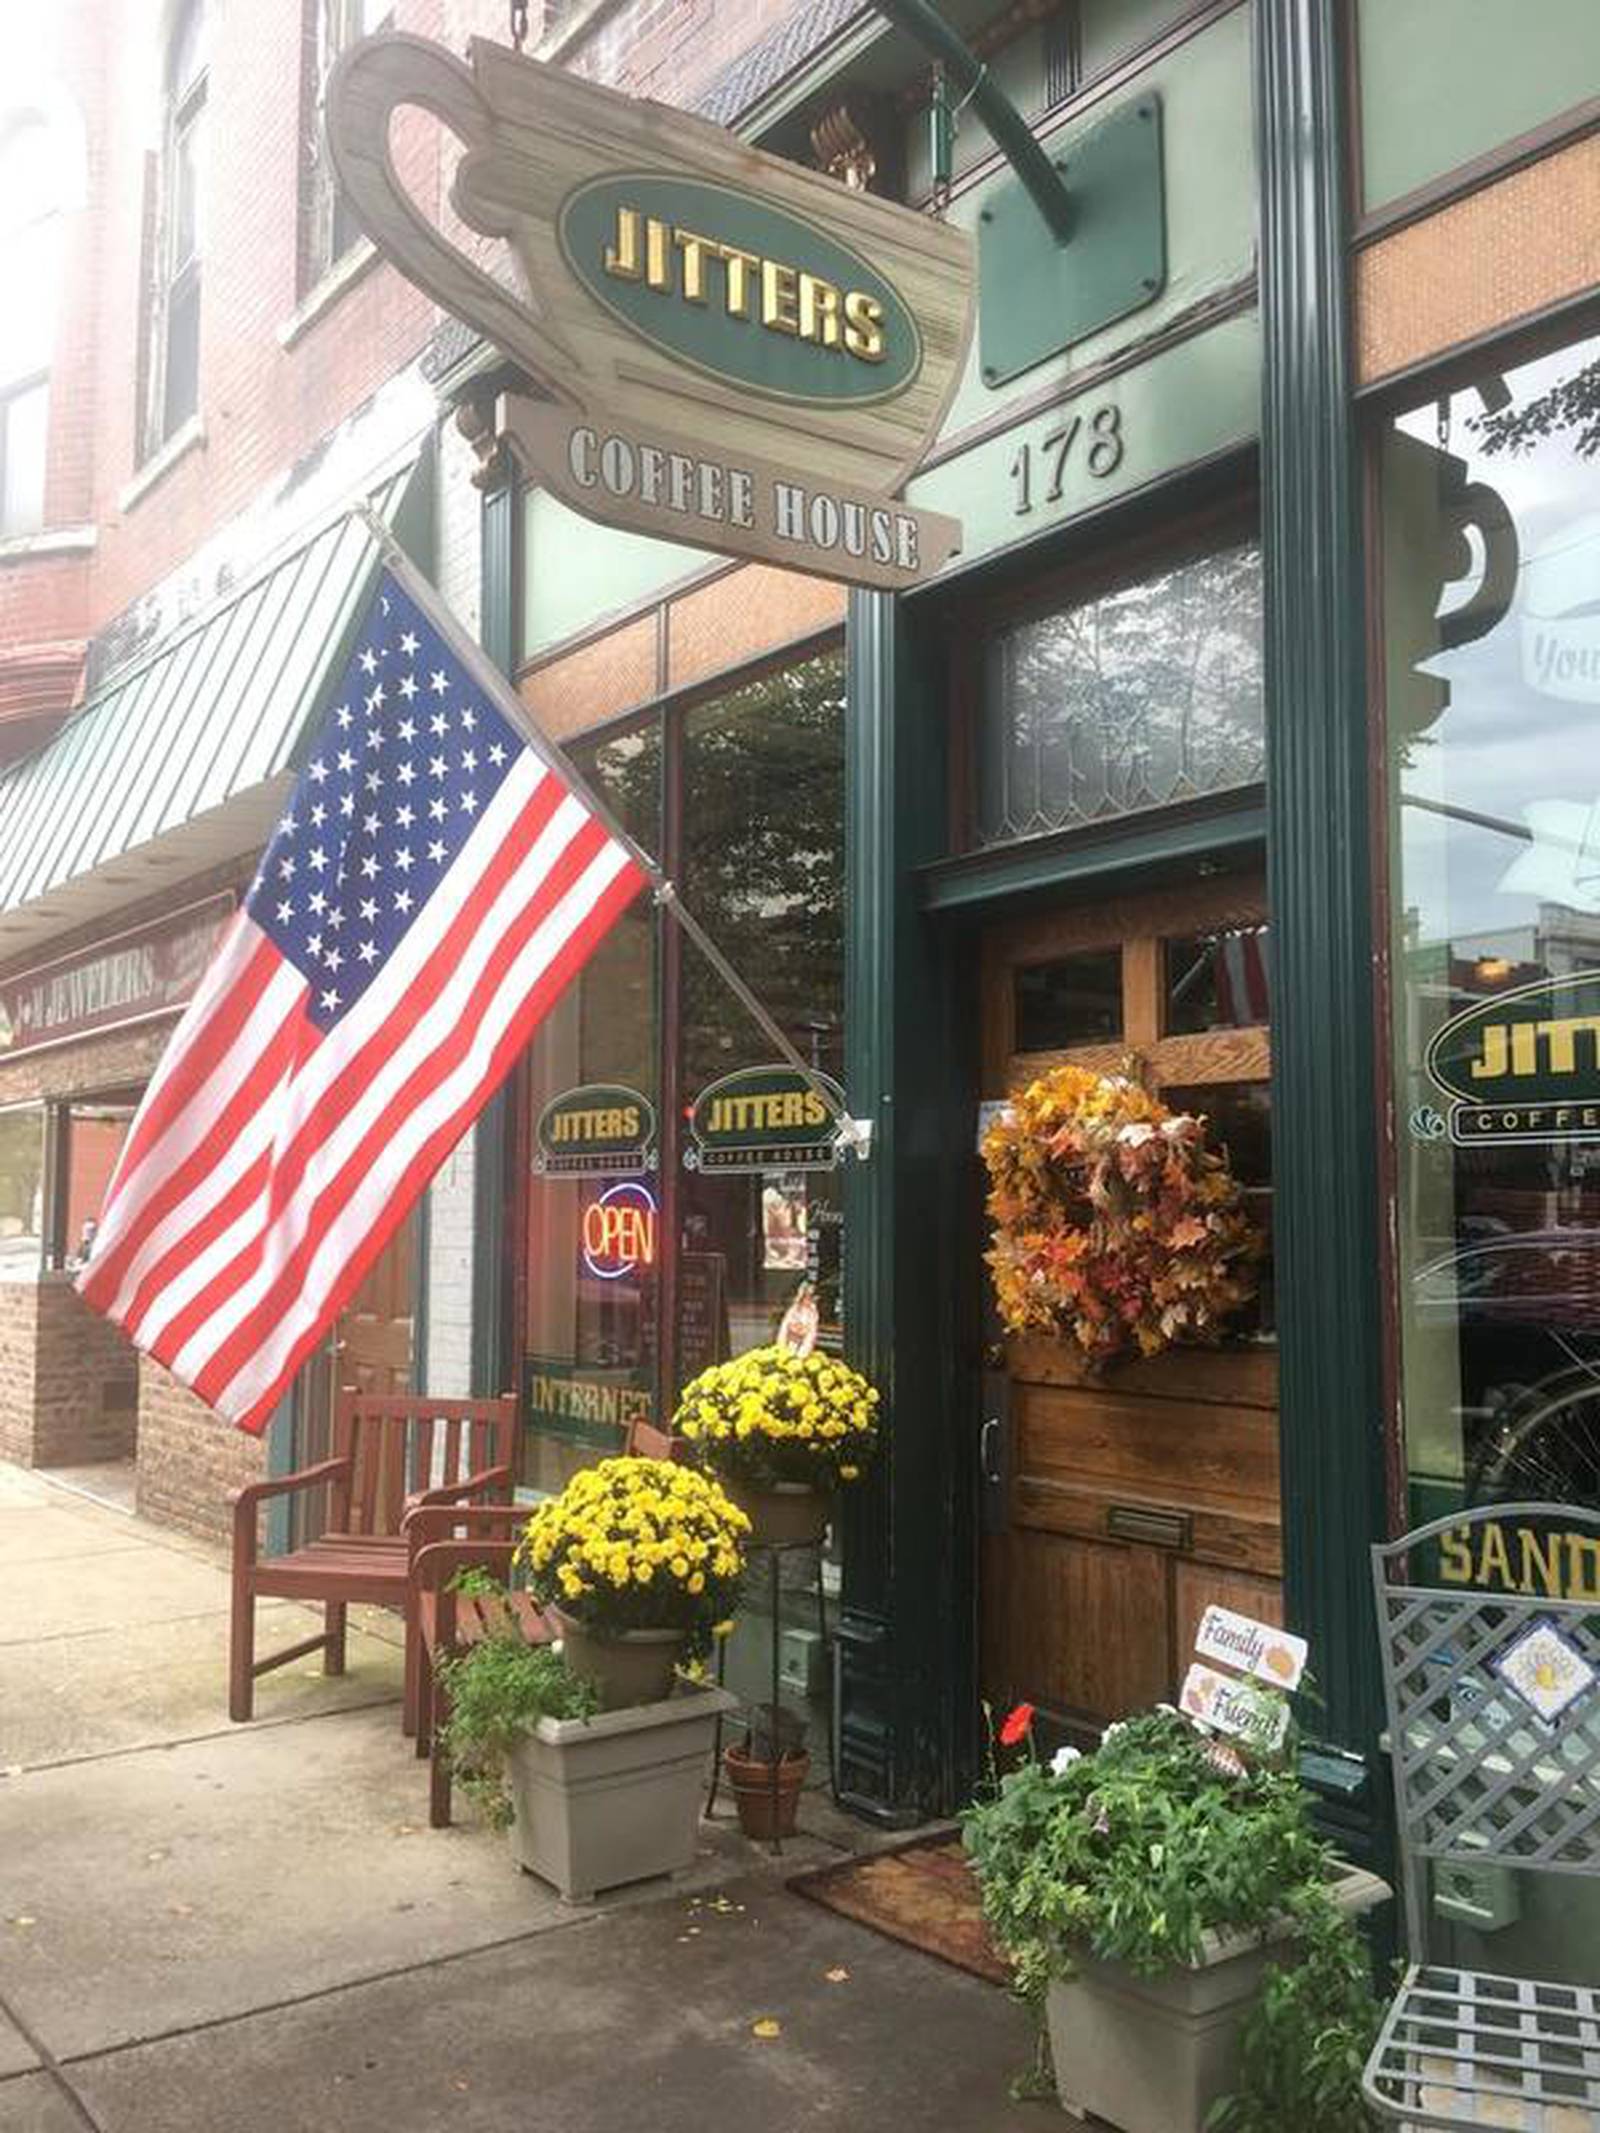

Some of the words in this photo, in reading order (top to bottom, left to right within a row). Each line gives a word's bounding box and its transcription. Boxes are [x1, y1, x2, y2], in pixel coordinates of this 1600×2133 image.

[605, 205, 887, 364] JITTERS
[1010, 404, 1123, 516] 178
[568, 426, 755, 530] COFFEE
[773, 484, 921, 571] HOUSE
[550, 1106, 640, 1142] JITTERS
[707, 1091, 828, 1132] JITTERS
[583, 1203, 655, 1264] OPEN
[532, 1375, 653, 1427] INTERNET
[1204, 1614, 1264, 1673] Family
